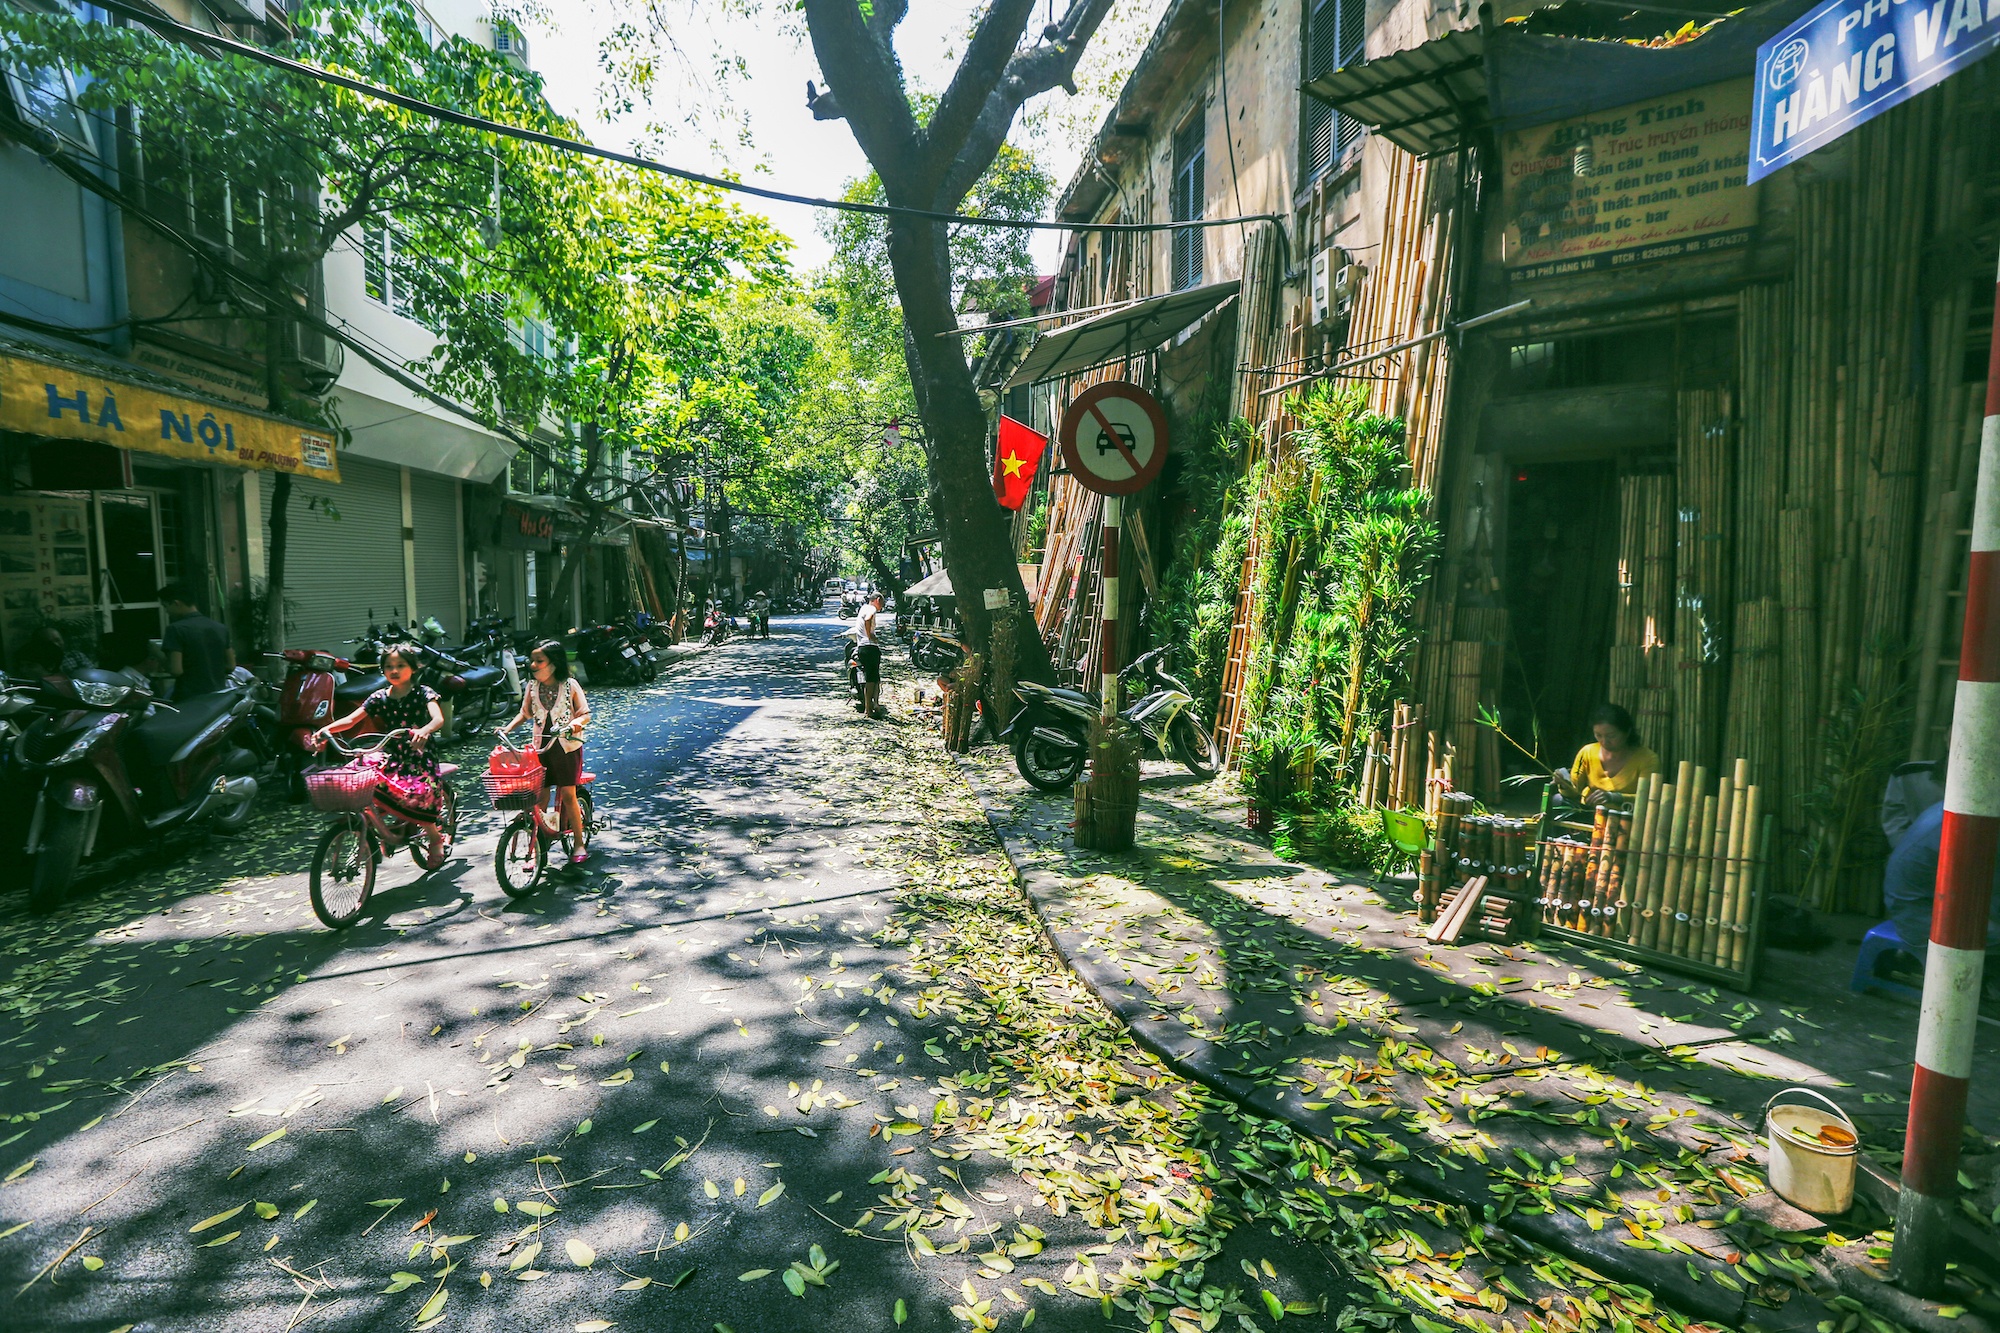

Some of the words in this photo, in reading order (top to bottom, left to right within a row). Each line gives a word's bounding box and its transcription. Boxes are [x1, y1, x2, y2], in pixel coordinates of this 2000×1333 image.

[1837, 0, 1906, 46] PH
[1773, 32, 1896, 147] HÀNG
[1658, 144, 1698, 162] thang
[1644, 170, 1673, 186] treo
[1646, 209, 1670, 224] bar
[139, 351, 176, 369] FAMILY
[177, 362, 234, 388] GUESTHOUSE
[45, 380, 125, 432] HÀ
[159, 409, 235, 454] NỘI
[239, 447, 254, 460] BIA
